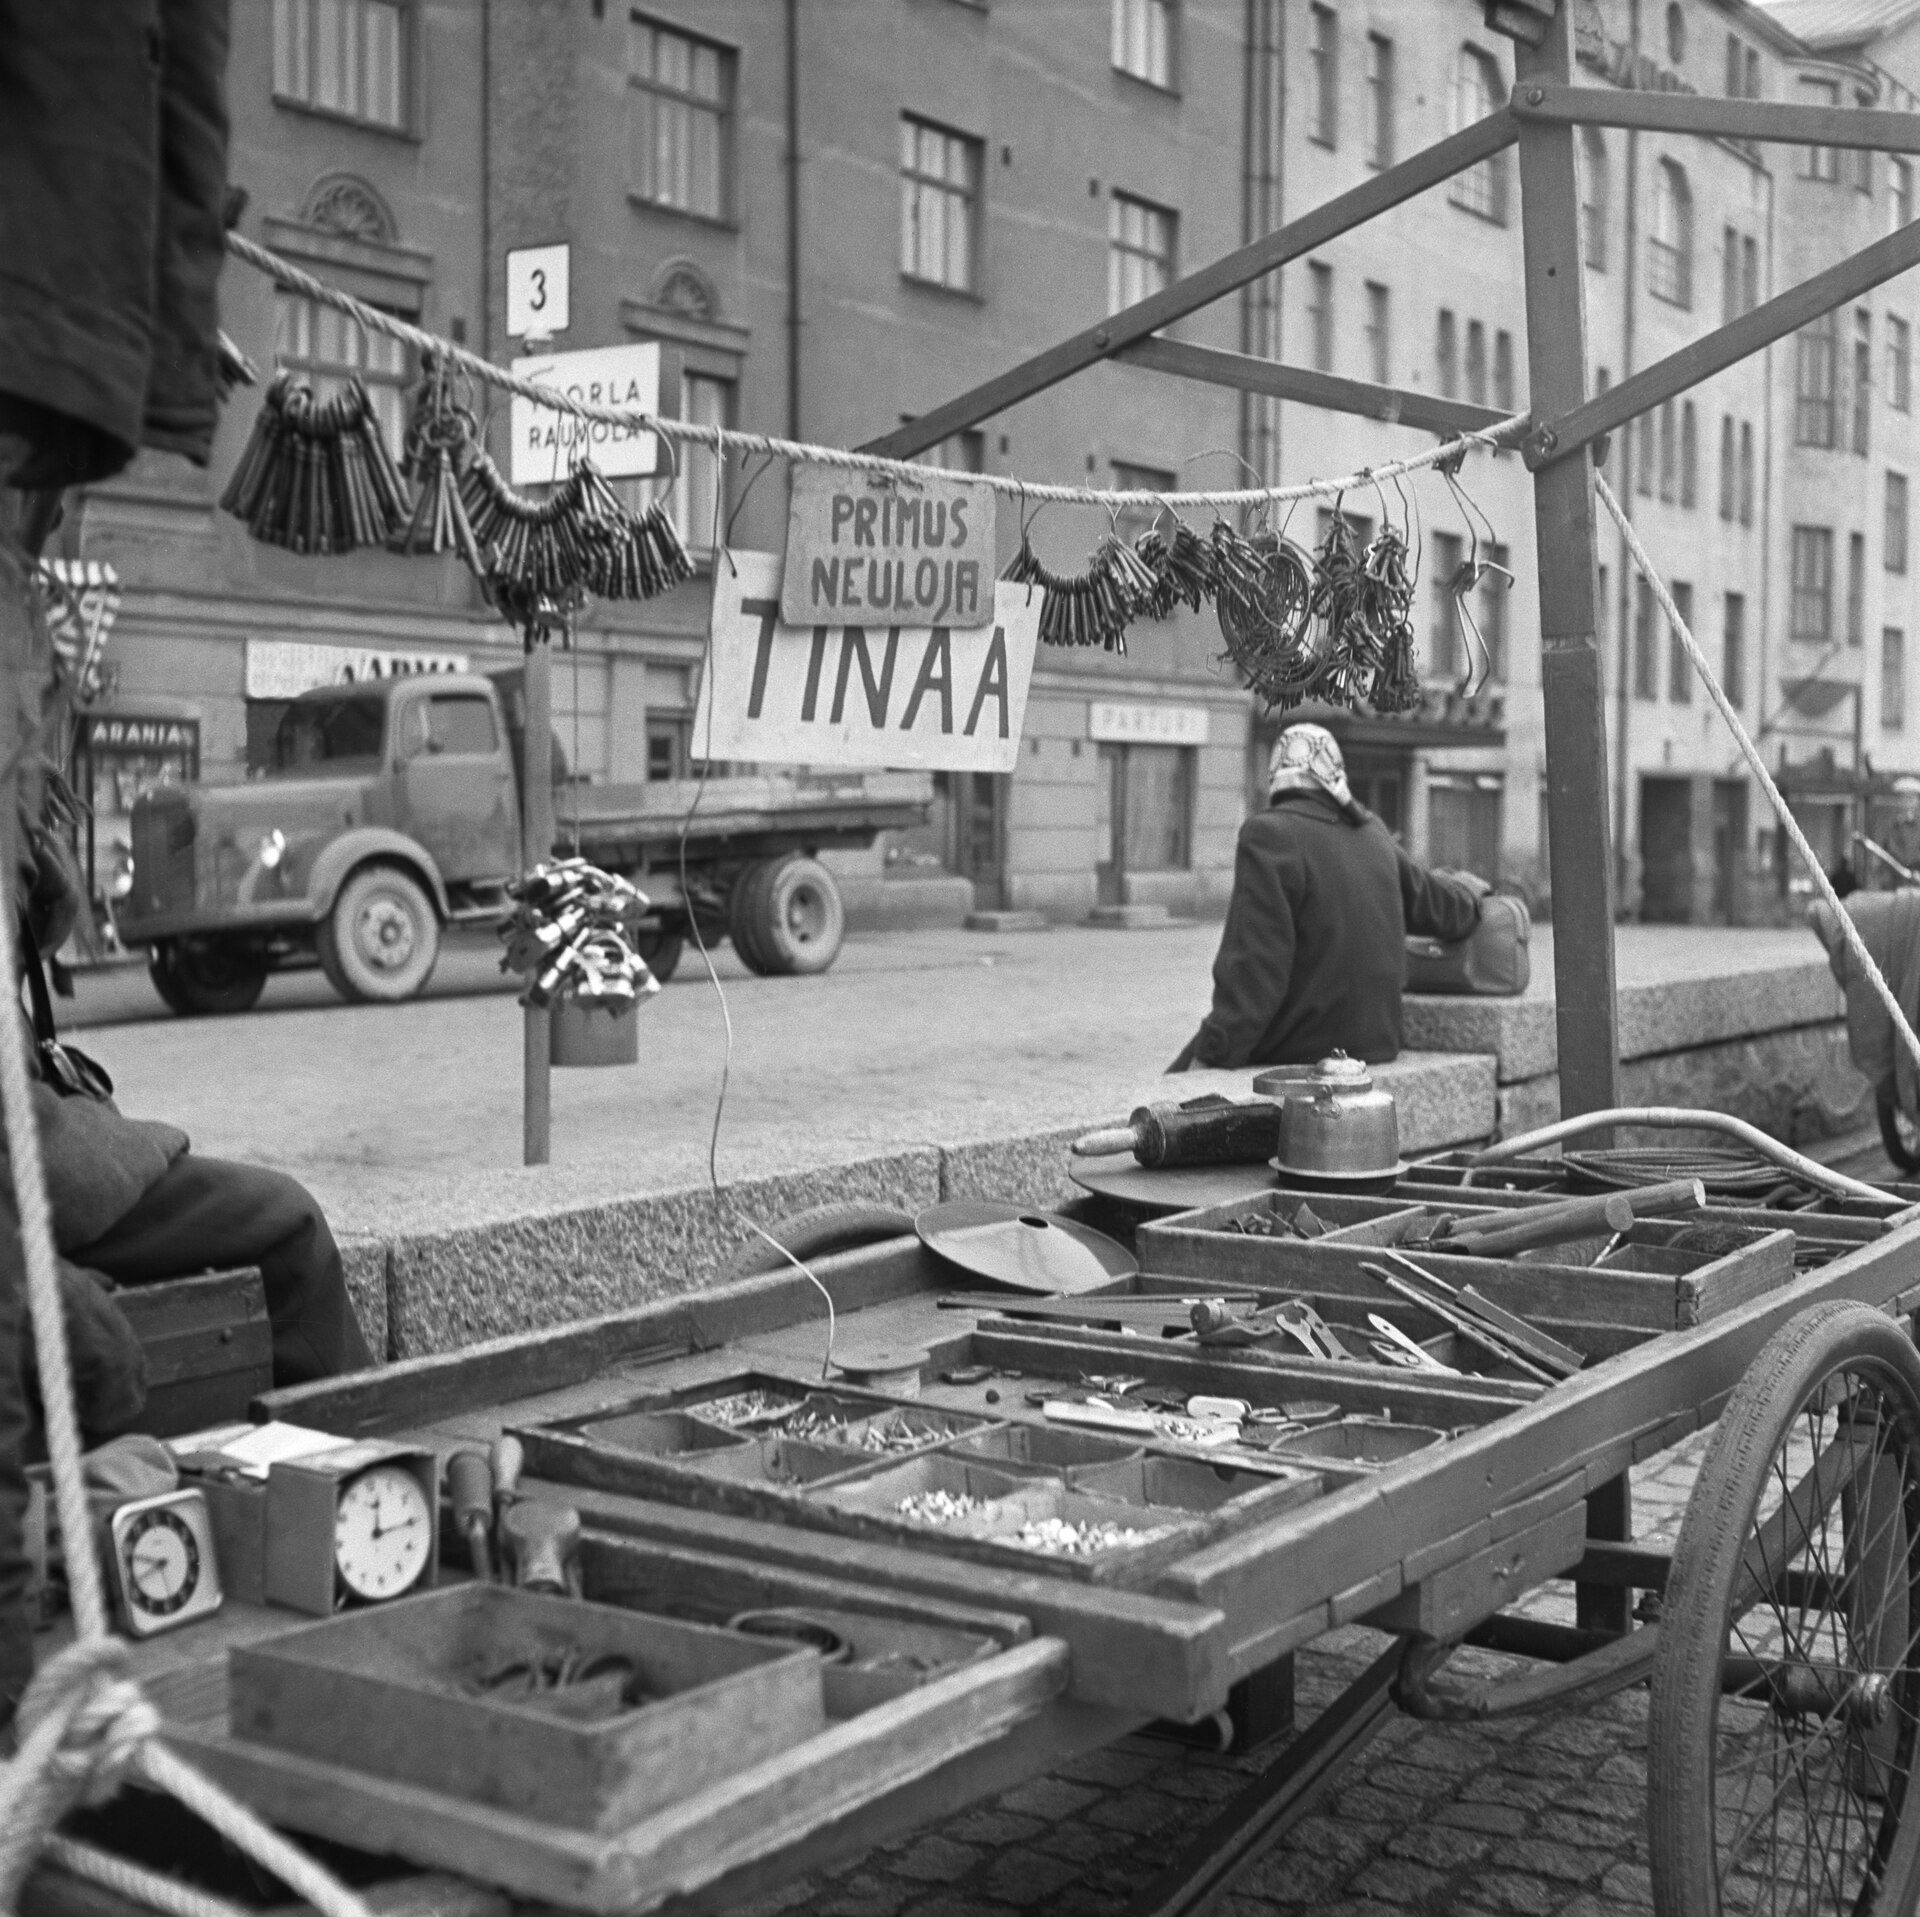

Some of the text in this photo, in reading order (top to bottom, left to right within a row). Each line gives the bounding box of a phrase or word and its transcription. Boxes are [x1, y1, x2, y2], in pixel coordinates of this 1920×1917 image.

[529, 268, 547, 312] 3
[831, 493, 969, 550] PRIMUS
[811, 555, 980, 623] NEULOJA
[740, 596, 1010, 740] TINAA
